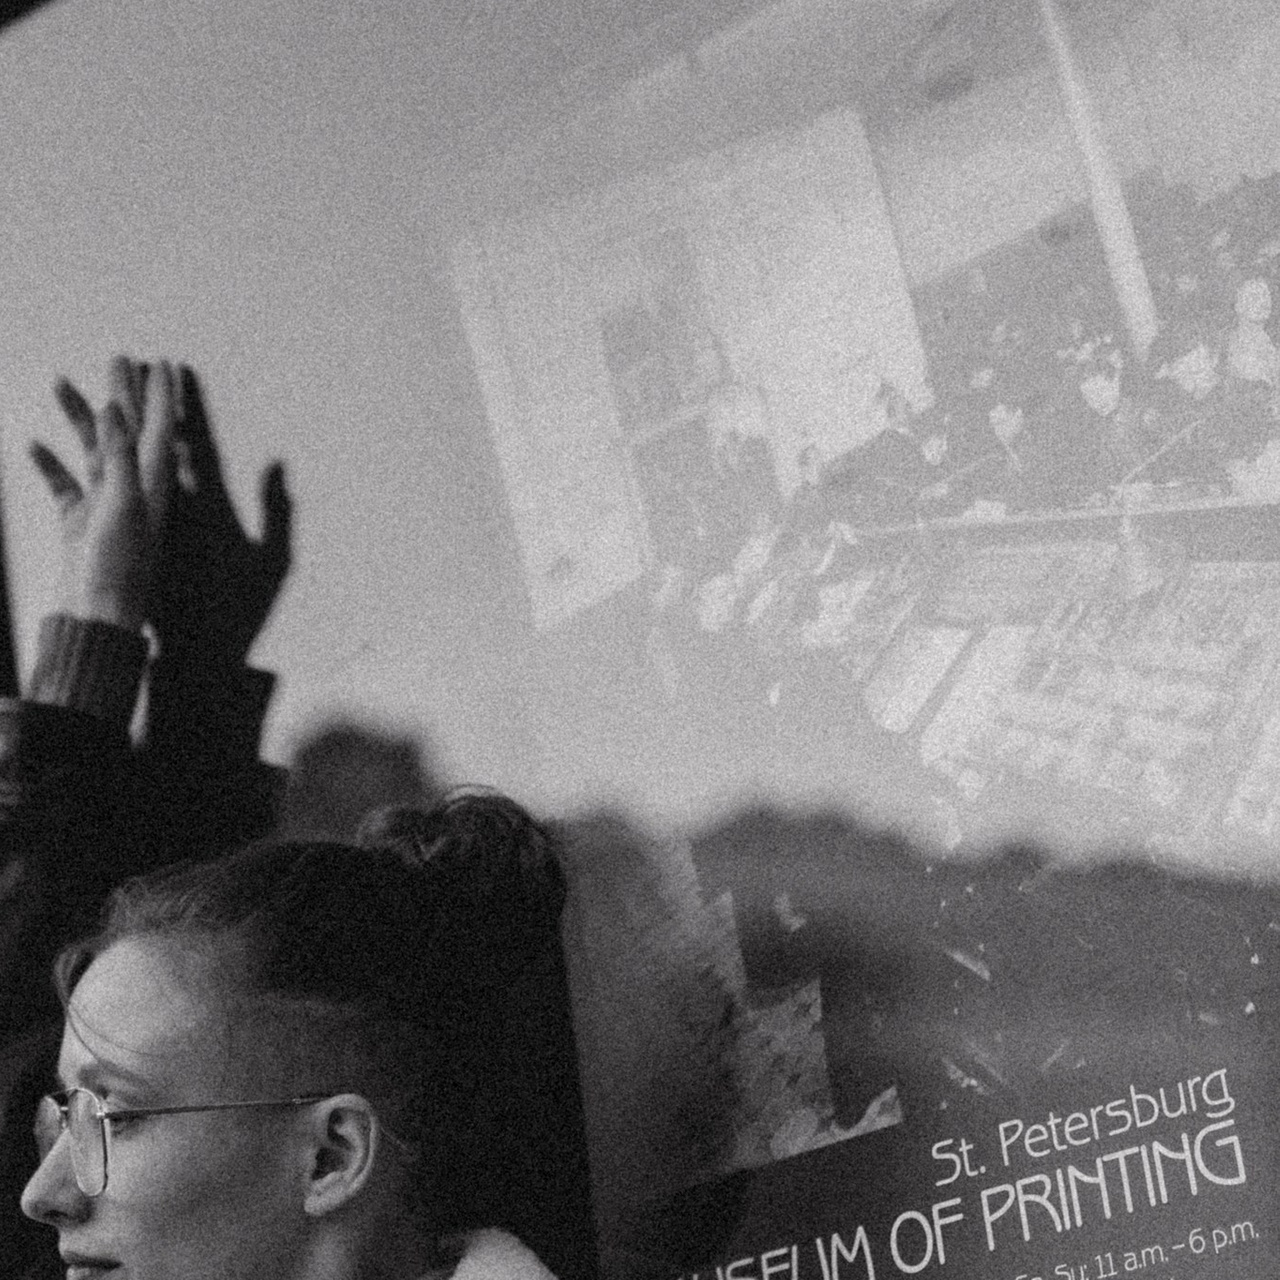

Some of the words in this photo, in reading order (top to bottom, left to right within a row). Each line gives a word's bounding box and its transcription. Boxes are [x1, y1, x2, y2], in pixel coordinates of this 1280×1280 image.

[930, 1137, 987, 1187] St.
[998, 1067, 1237, 1167] Petersburg
[889, 1196, 965, 1275] OF
[979, 1118, 1248, 1252] PRINTING
[1094, 1252, 1119, 1280] 11
[1122, 1244, 1170, 1272] a.m.
[1188, 1227, 1207, 1255] 6
[1211, 1220, 1261, 1255] p.m.
